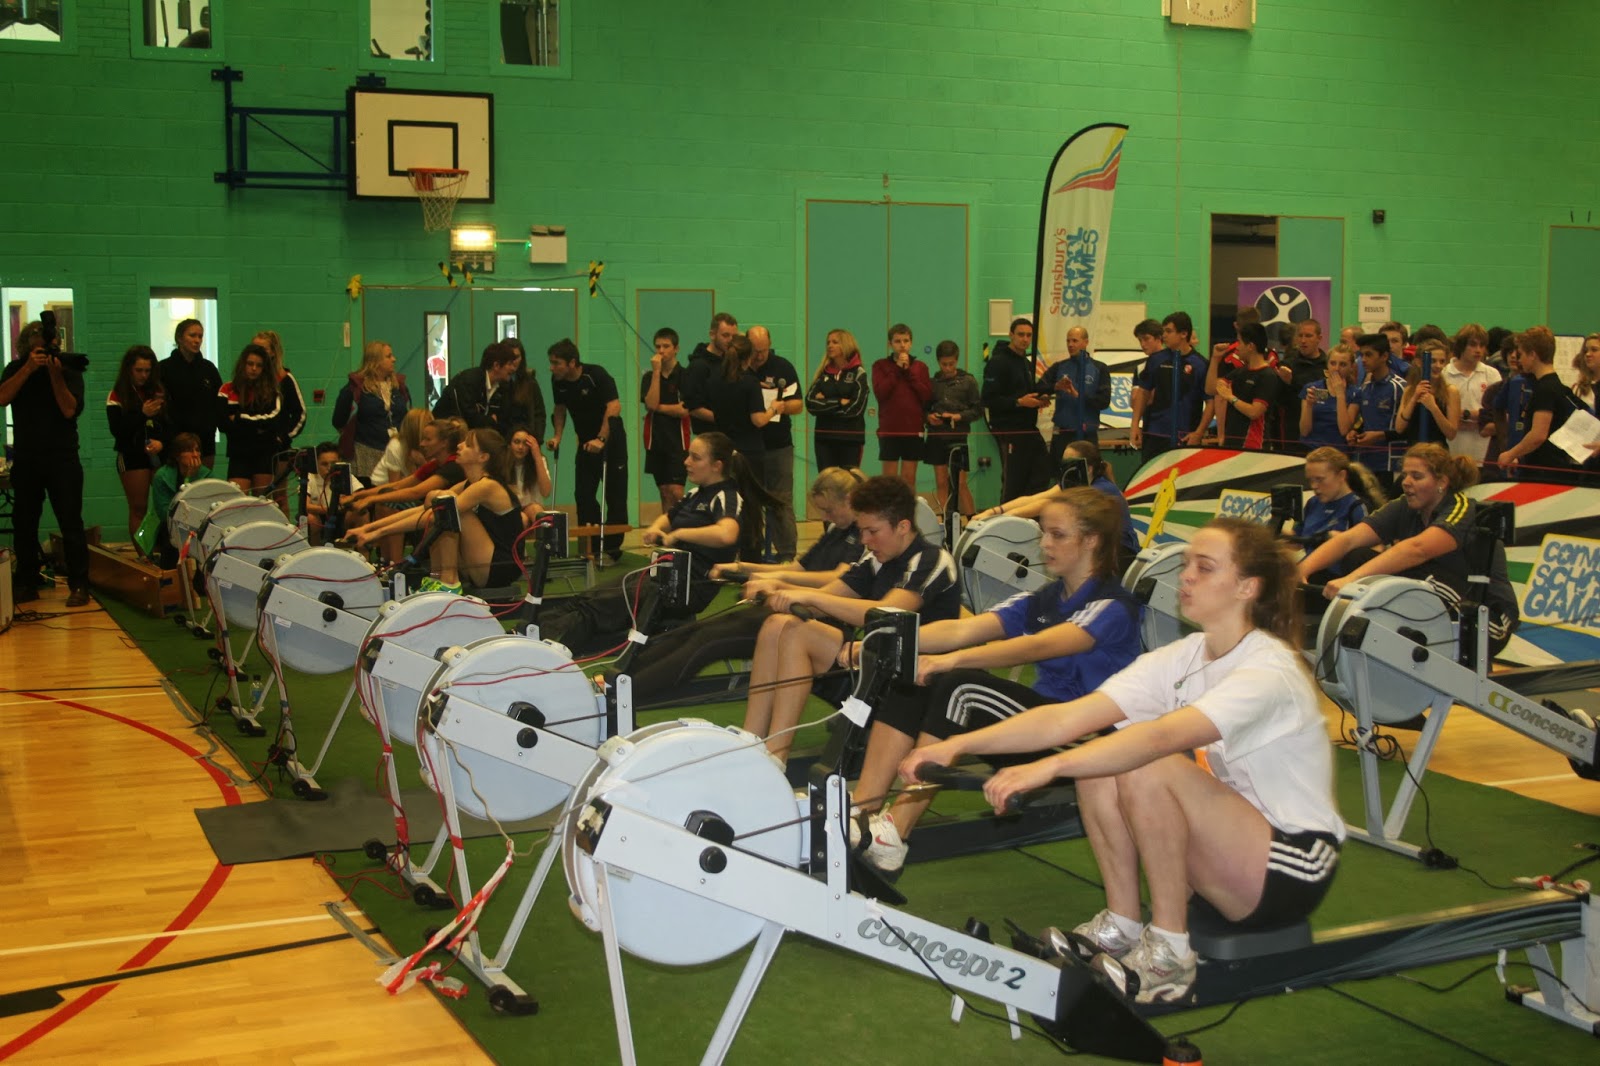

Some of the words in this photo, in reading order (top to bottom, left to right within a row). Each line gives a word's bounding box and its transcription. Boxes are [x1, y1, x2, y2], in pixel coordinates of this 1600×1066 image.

[1050, 228, 1067, 315] Sainsbury's
[1061, 226, 1083, 317] SCHOOL
[1077, 229, 1099, 317] GAMES
[1510, 703, 1576, 743] concept
[1575, 734, 1588, 749] 2
[857, 917, 1005, 982] concept
[1003, 966, 1026, 990] 2
